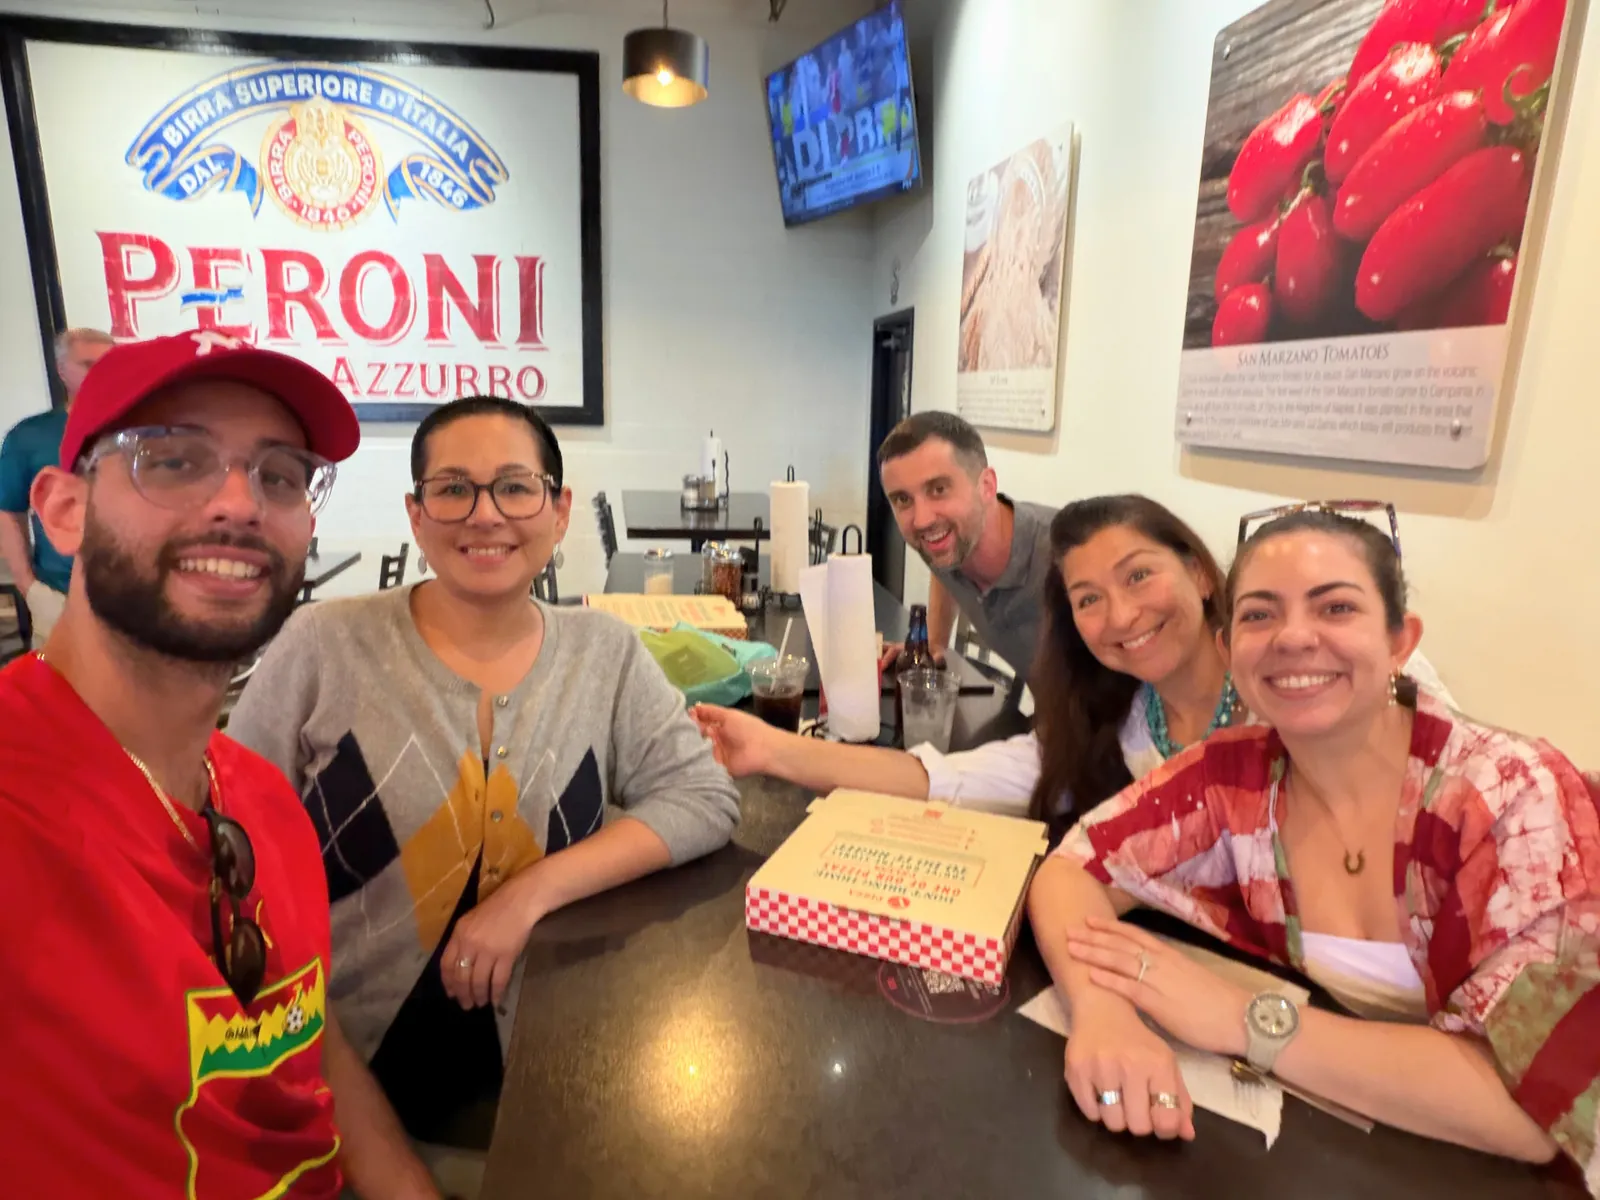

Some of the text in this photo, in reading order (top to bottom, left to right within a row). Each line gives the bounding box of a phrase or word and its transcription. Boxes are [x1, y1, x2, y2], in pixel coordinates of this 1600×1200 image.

[162, 73, 470, 163] BIRRA SUPERIORE D'ITALIA
[178, 154, 226, 194] DAL
[269, 131, 294, 200] BIRRA
[347, 130, 375, 207] PERONI
[420, 163, 469, 208] 1846
[300, 203, 352, 223] 1846
[95, 230, 549, 351] PERONI
[1237, 342, 1390, 367] SAN MARZANO TOMATOES
[330, 356, 548, 400] AZZURRO
